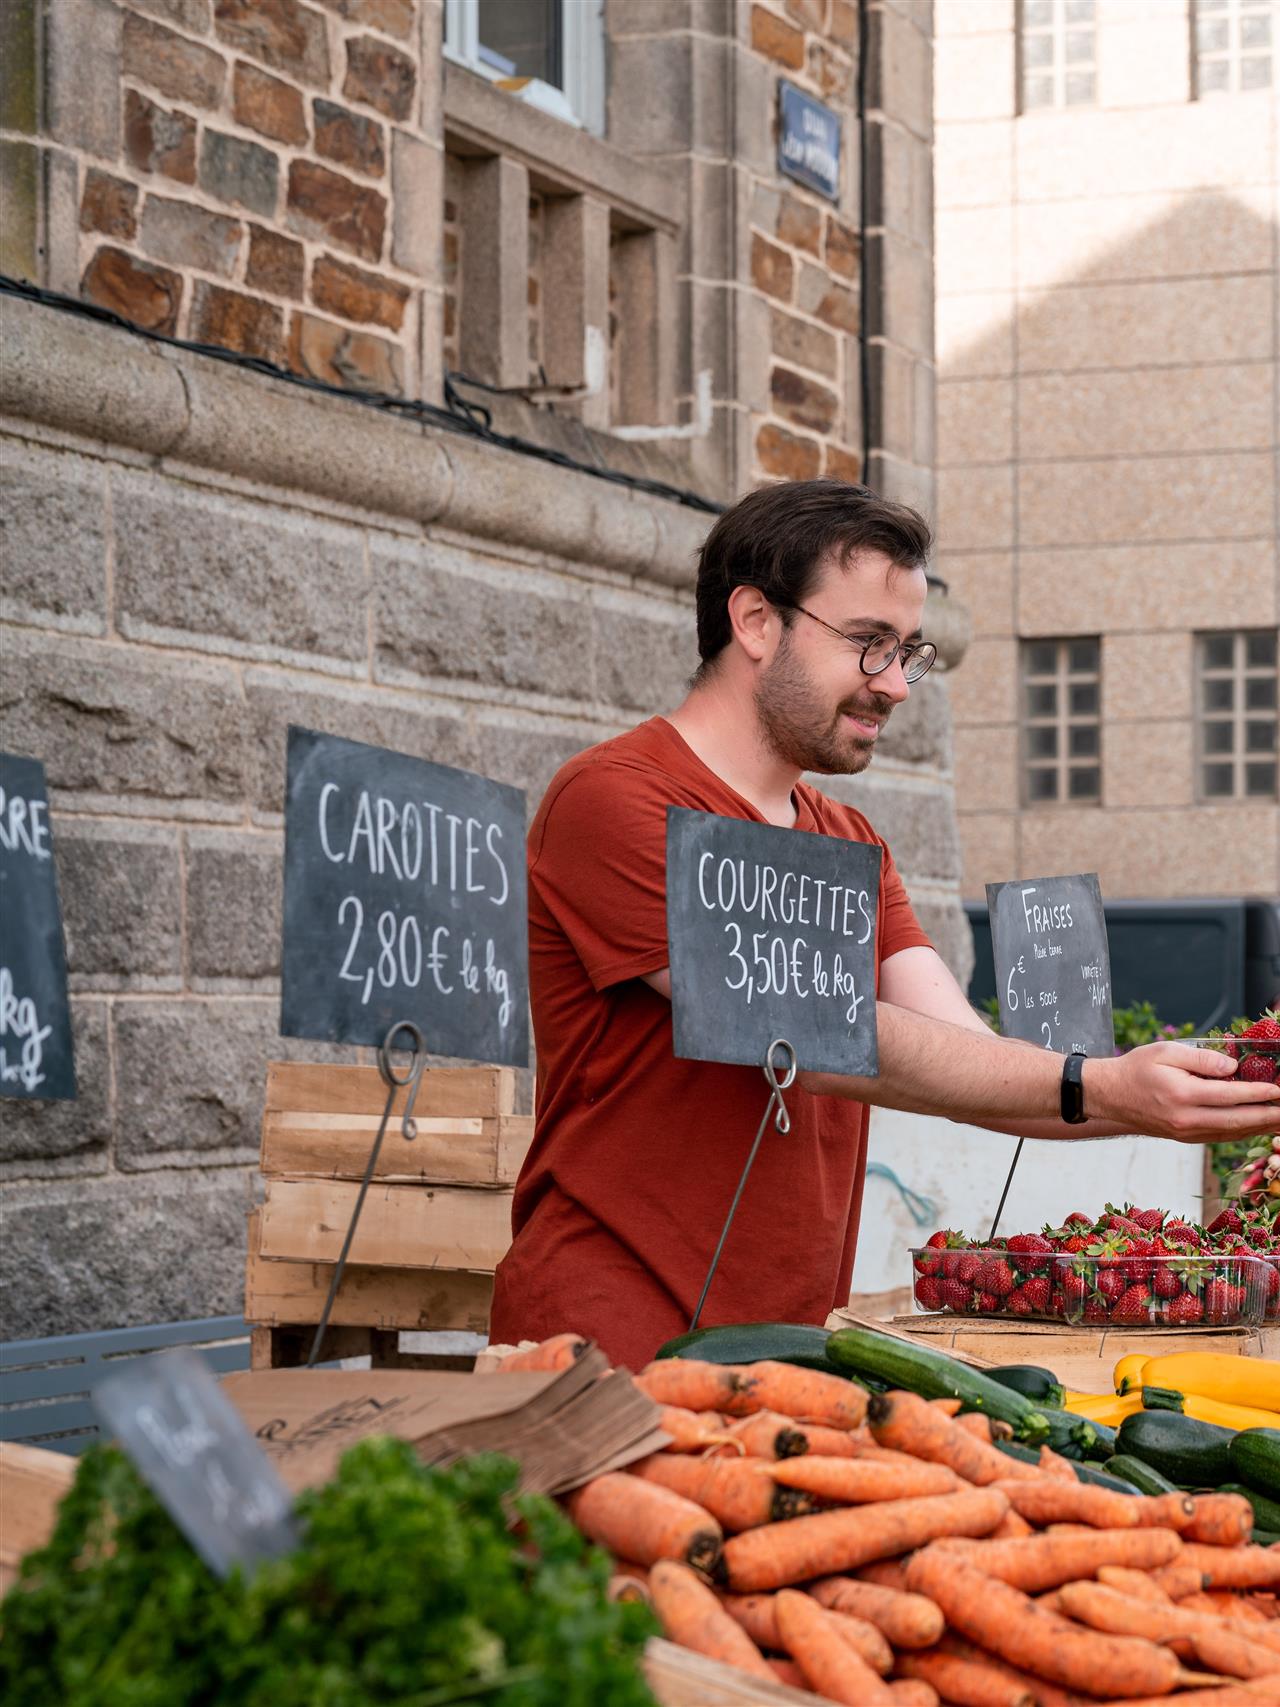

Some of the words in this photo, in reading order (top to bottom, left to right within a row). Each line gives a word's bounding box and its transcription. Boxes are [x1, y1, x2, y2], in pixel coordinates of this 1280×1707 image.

[317, 782, 510, 906] CAROTTES
[698, 852, 872, 945] COURGETTES
[1021, 887, 1074, 934] FRAISES
[338, 895, 454, 1005] 2,80€
[459, 938, 481, 994] le
[484, 938, 512, 1028] kg
[724, 921, 809, 1005] 3,50€
[812, 950, 830, 998] le
[833, 953, 865, 1024] kg
